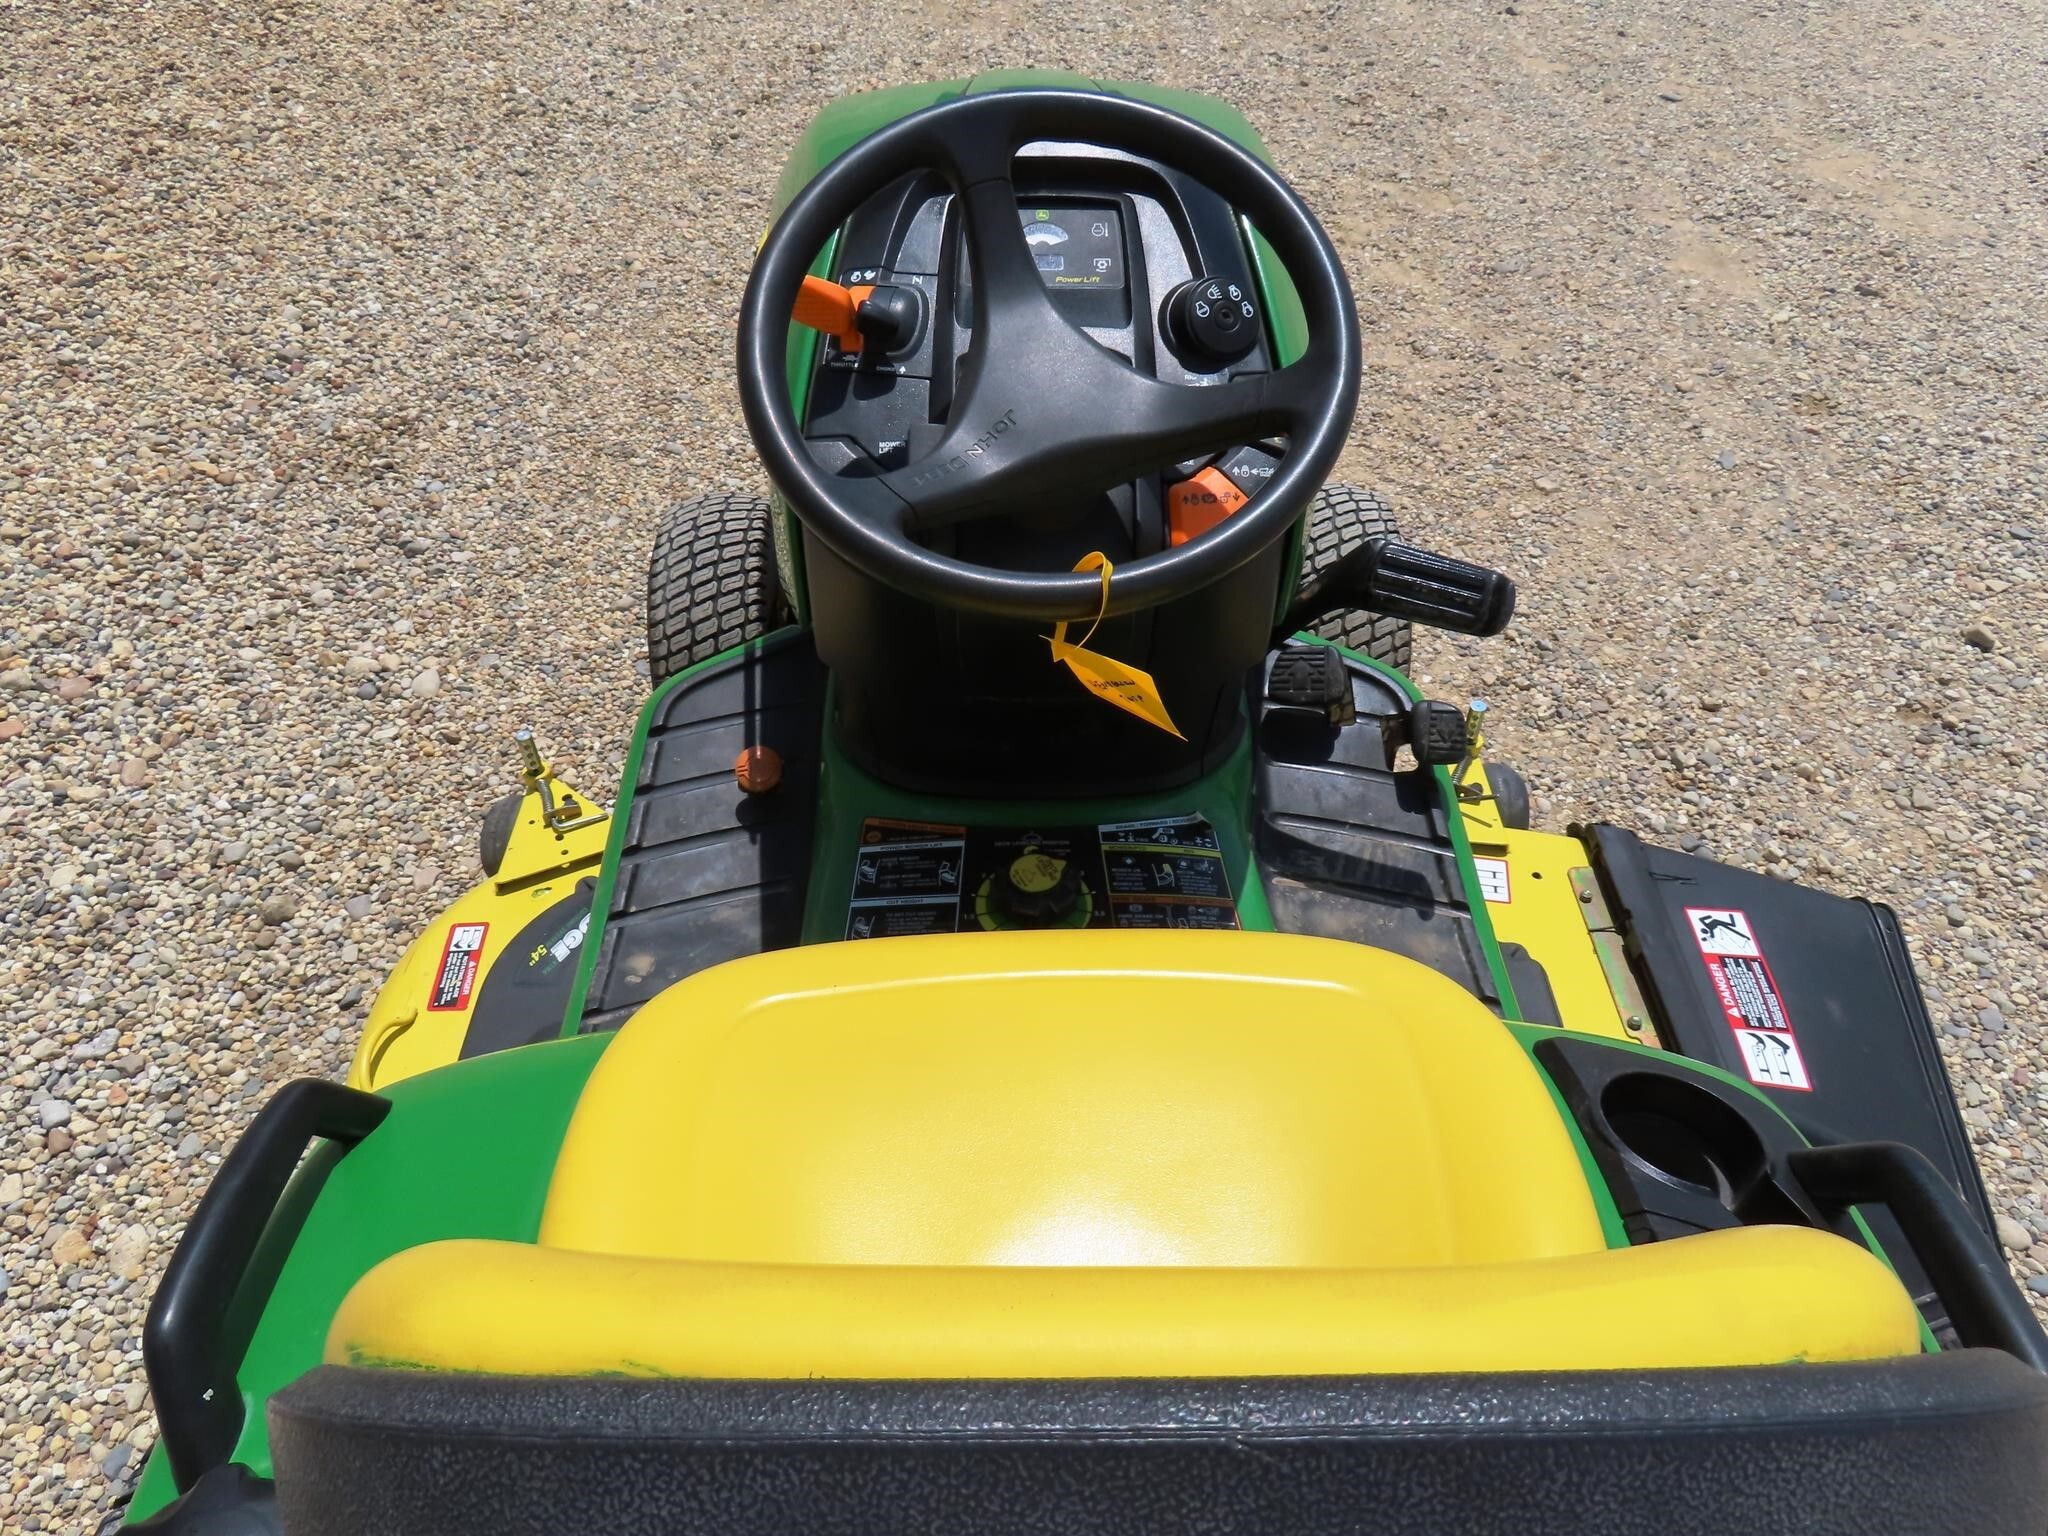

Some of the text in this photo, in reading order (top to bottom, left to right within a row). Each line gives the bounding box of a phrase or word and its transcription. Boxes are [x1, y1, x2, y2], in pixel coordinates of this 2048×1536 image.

[965, 408, 1017, 459] JOHN
[457, 955, 468, 980] ROTATING
[528, 943, 548, 967] 54"
[462, 967, 475, 994] DANGER
[1709, 963, 1735, 1005] DANGER
